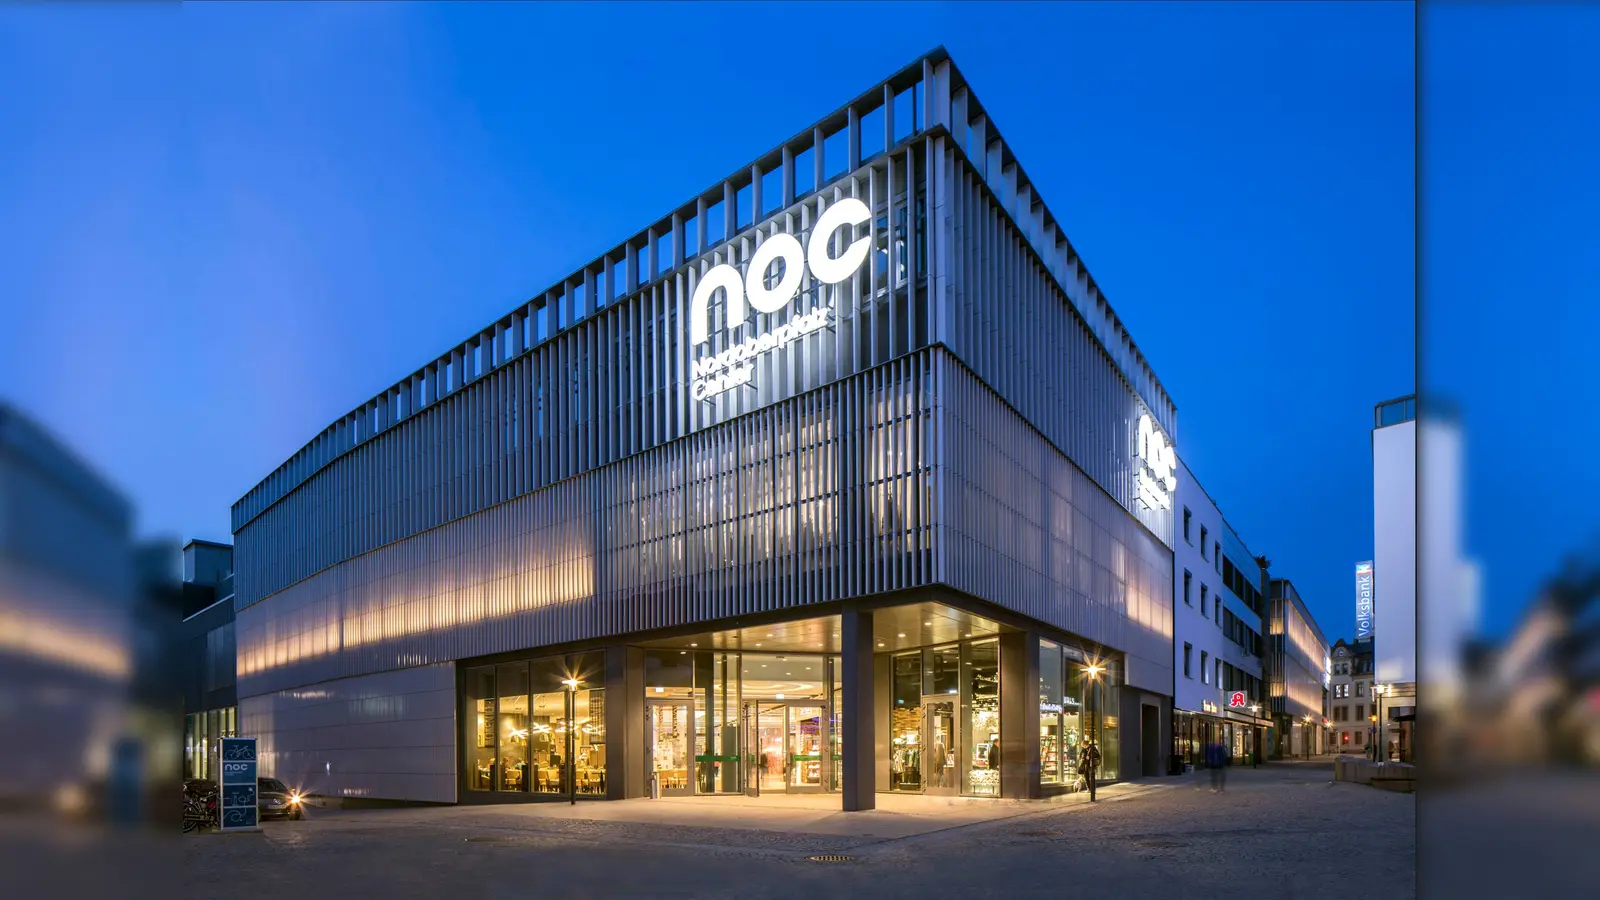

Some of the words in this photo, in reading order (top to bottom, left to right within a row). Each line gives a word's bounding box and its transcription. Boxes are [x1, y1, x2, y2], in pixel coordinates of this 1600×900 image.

[691, 197, 872, 346] noc
[692, 363, 754, 401] Center
[1358, 576, 1370, 636] Volksbank
[224, 763, 248, 771] noc
